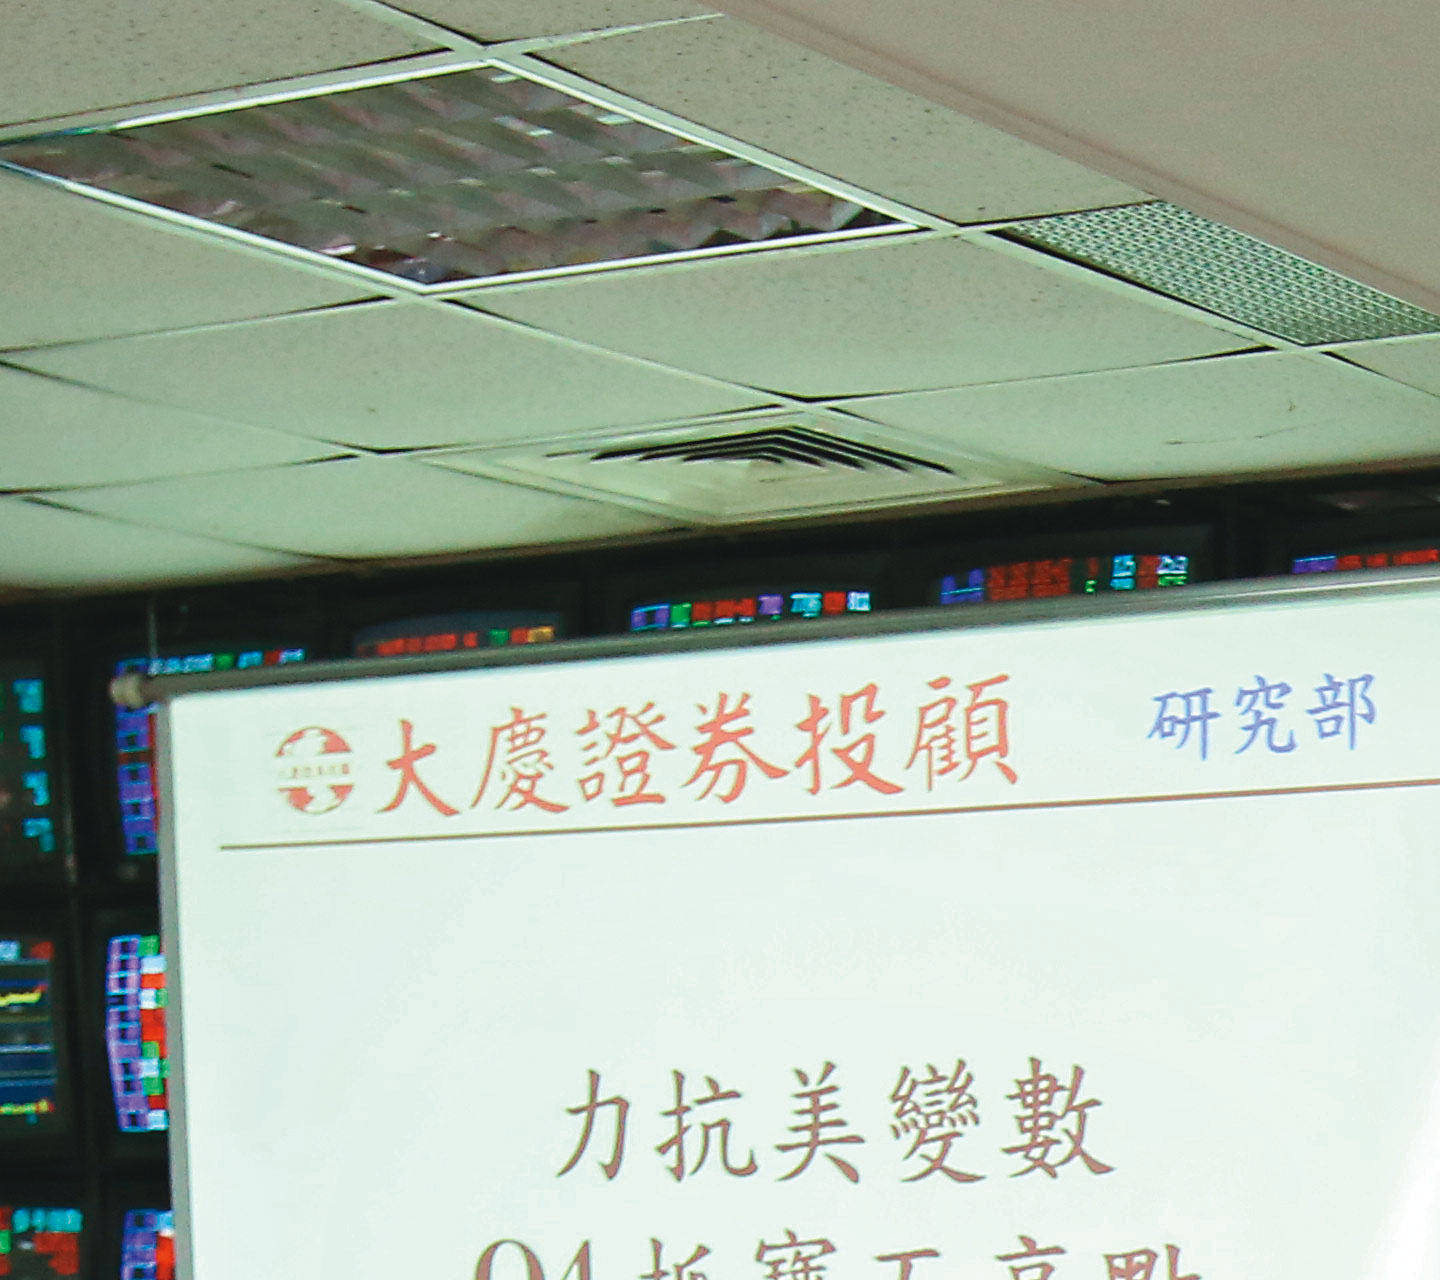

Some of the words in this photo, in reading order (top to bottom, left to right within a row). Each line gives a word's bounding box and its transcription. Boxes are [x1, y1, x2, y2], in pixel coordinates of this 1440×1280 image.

[376, 673, 1023, 820] 大慶證券投顧
[1146, 673, 1377, 762] 研究部
[556, 1057, 1115, 1184] 力抗美變數
